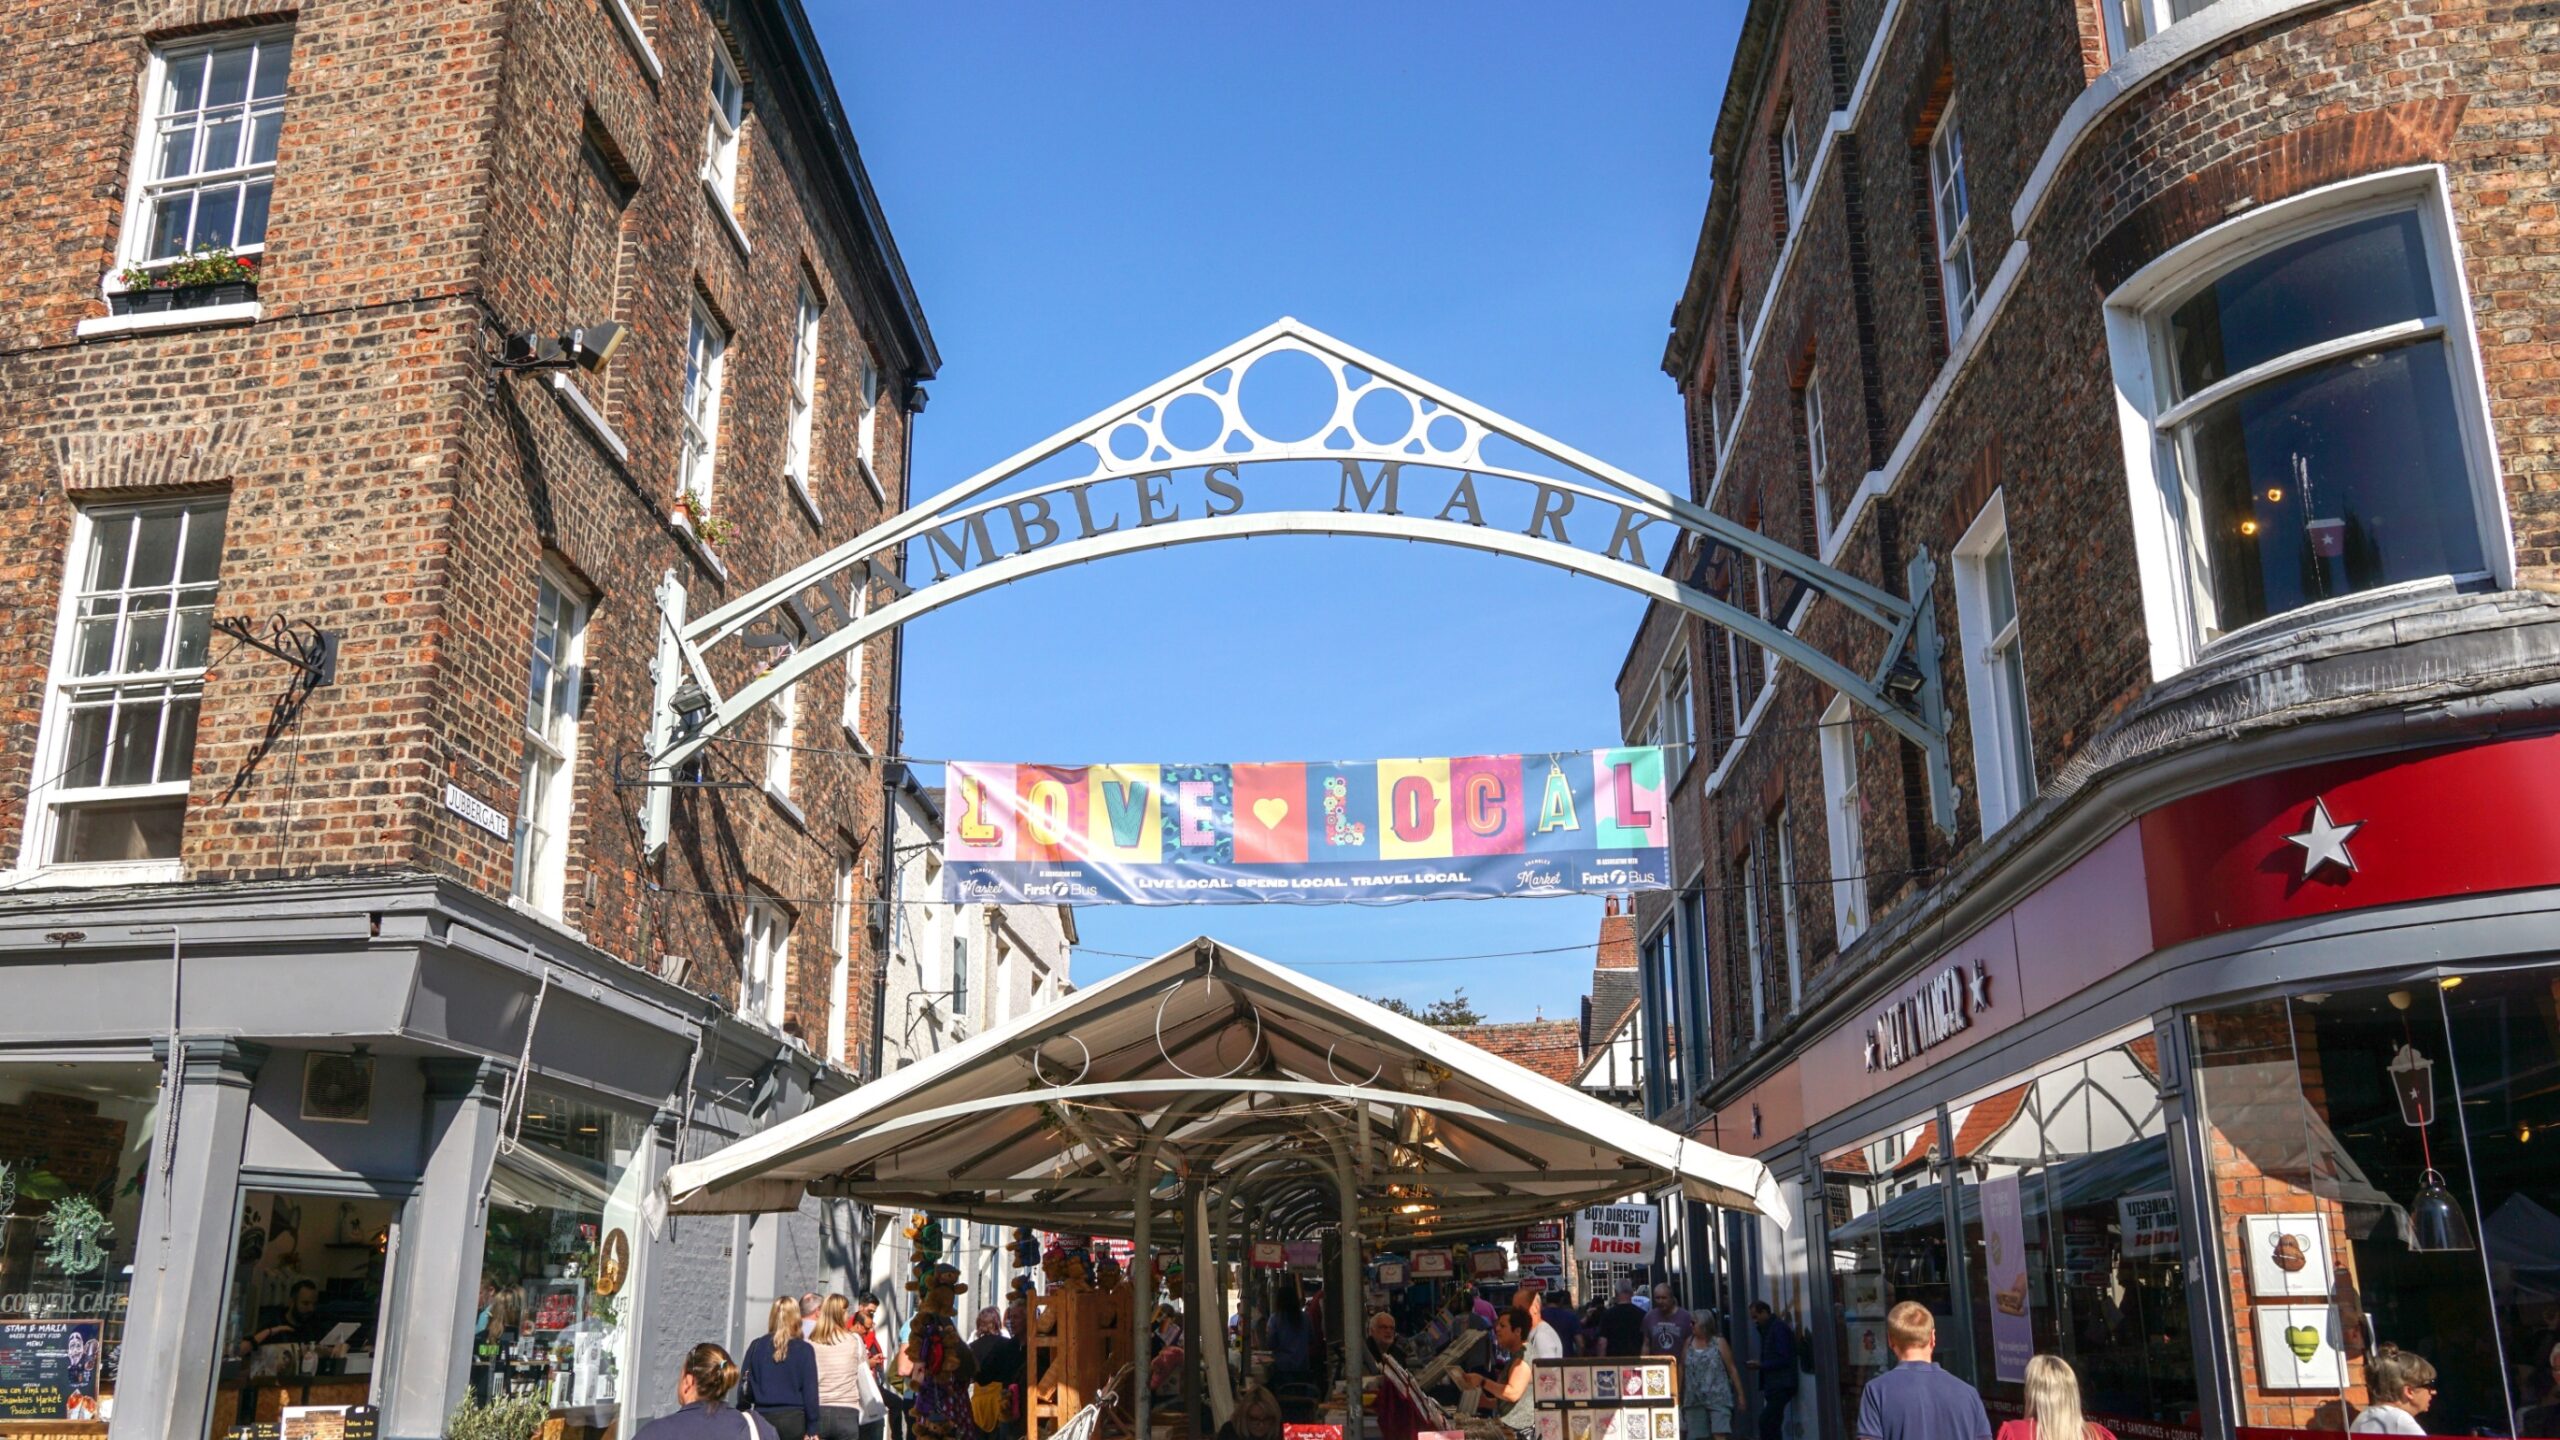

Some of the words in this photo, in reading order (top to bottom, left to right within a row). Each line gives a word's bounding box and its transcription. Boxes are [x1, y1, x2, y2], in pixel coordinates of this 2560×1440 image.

[741, 462, 1244, 648] SHAMBLES
[1332, 460, 1825, 632] MARKET
[449, 788, 506, 836] JUBBERGATE
[959, 775, 1215, 848] LOVE
[1324, 763, 1651, 847] LOCAL
[1139, 878, 1174, 889] LIVE
[1176, 878, 1233, 889] LOCAL.
[1236, 878, 1289, 888] SPEND
[1291, 877, 1348, 888] LOCAL.
[1351, 875, 1412, 886] TRAVEL
[1415, 872, 1472, 883] LOCAL.
[1516, 869, 1562, 889] Market
[1582, 872, 1609, 885] First
[1628, 870, 1655, 884] Bus
[959, 879, 1004, 898] Market
[1024, 883, 1051, 896] First
[1070, 883, 1097, 896] Bus
[1584, 1207, 1604, 1221] BUY
[1605, 1207, 1650, 1224] DIRECTLY
[1592, 1221, 1619, 1237] FROM
[1623, 1223, 1641, 1238] THE
[1589, 1237, 1641, 1254] Artist
[1, 1292, 75, 1313] CORNER
[79, 1292, 128, 1313] CAFE
[4, 1324, 27, 1333] STAM
[38, 1324, 67, 1333] MARIA
[26, 1340, 44, 1348] MENU
[10, 1387, 22, 1395] can
[24, 1386, 39, 1395] find
[36, 1394, 62, 1407] Market
[2103, 1418, 2120, 1431] LATTE
[2127, 1421, 2163, 1438] SANDWICHES
